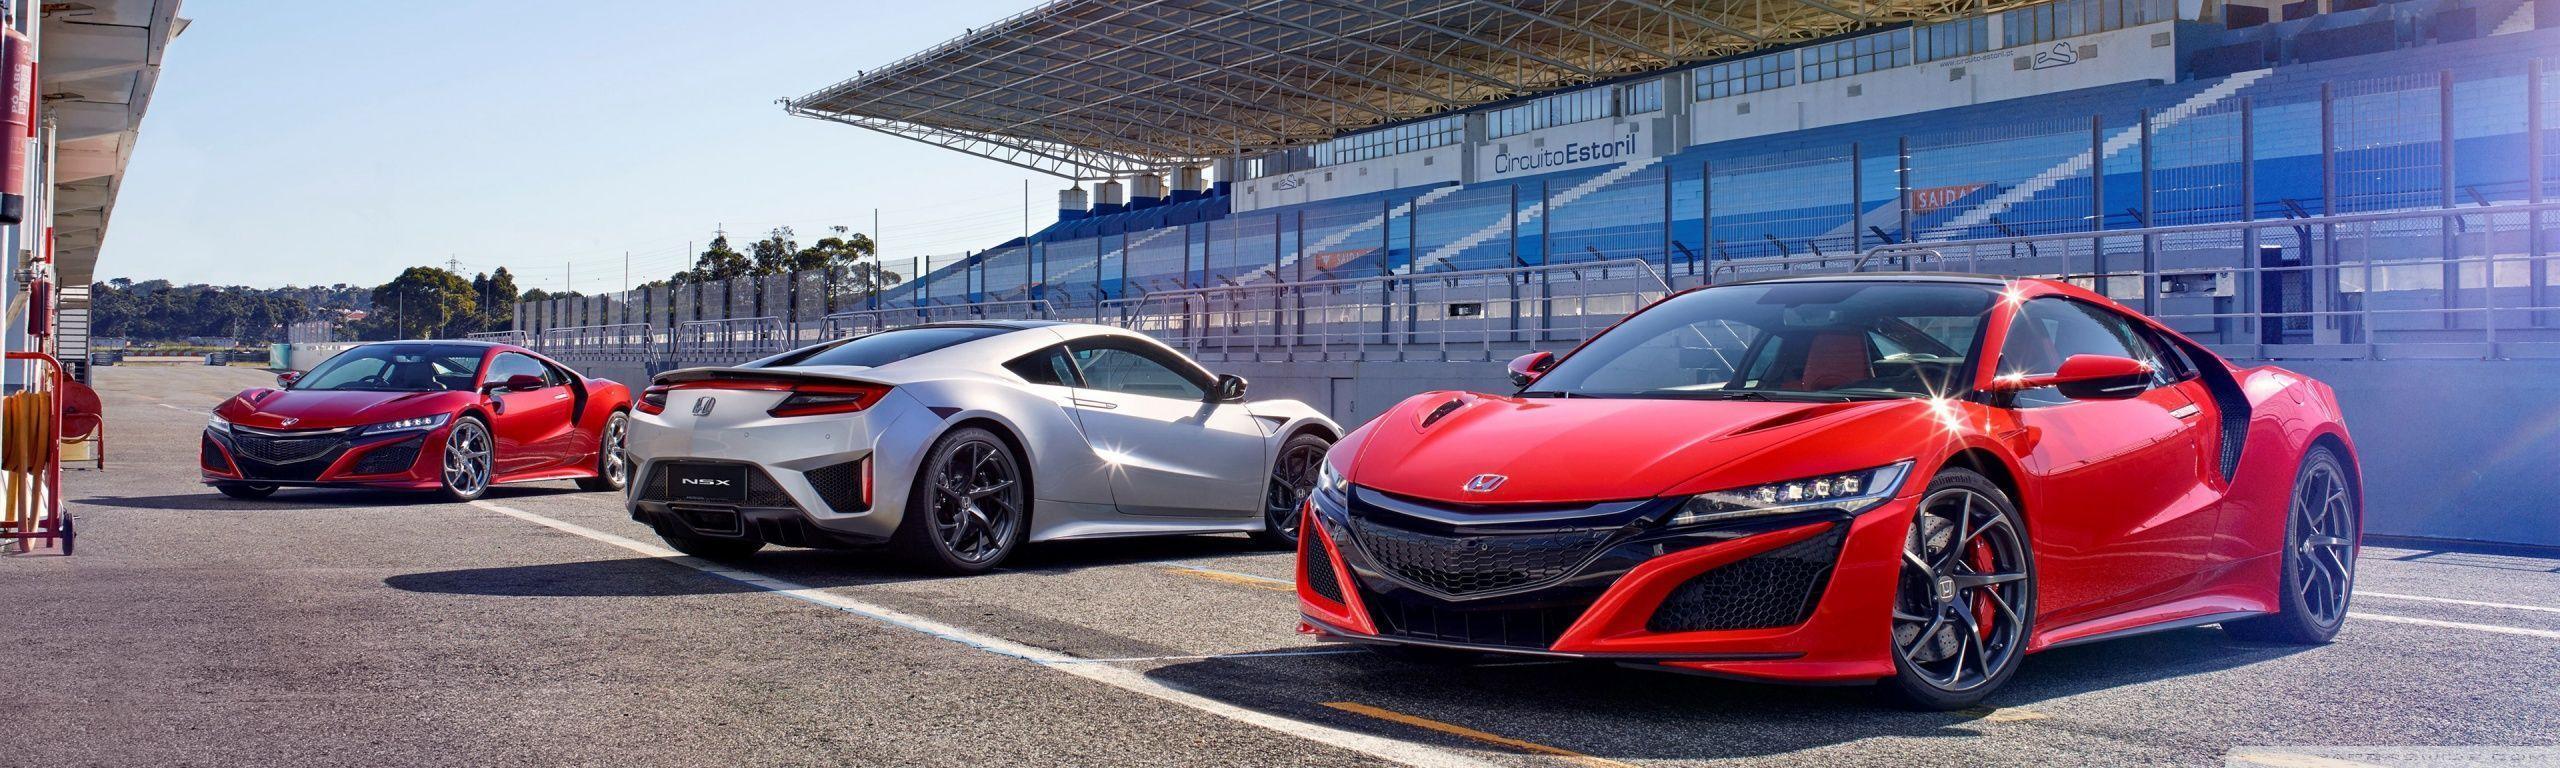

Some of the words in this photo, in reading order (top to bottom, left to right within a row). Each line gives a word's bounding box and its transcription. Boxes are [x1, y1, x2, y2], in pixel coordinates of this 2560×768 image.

[13, 63, 21, 91] ABC
[1494, 133, 1636, 174] CircuitoEstoril
[682, 478, 730, 486] NSX
[1927, 474, 1971, 488] ontinental
